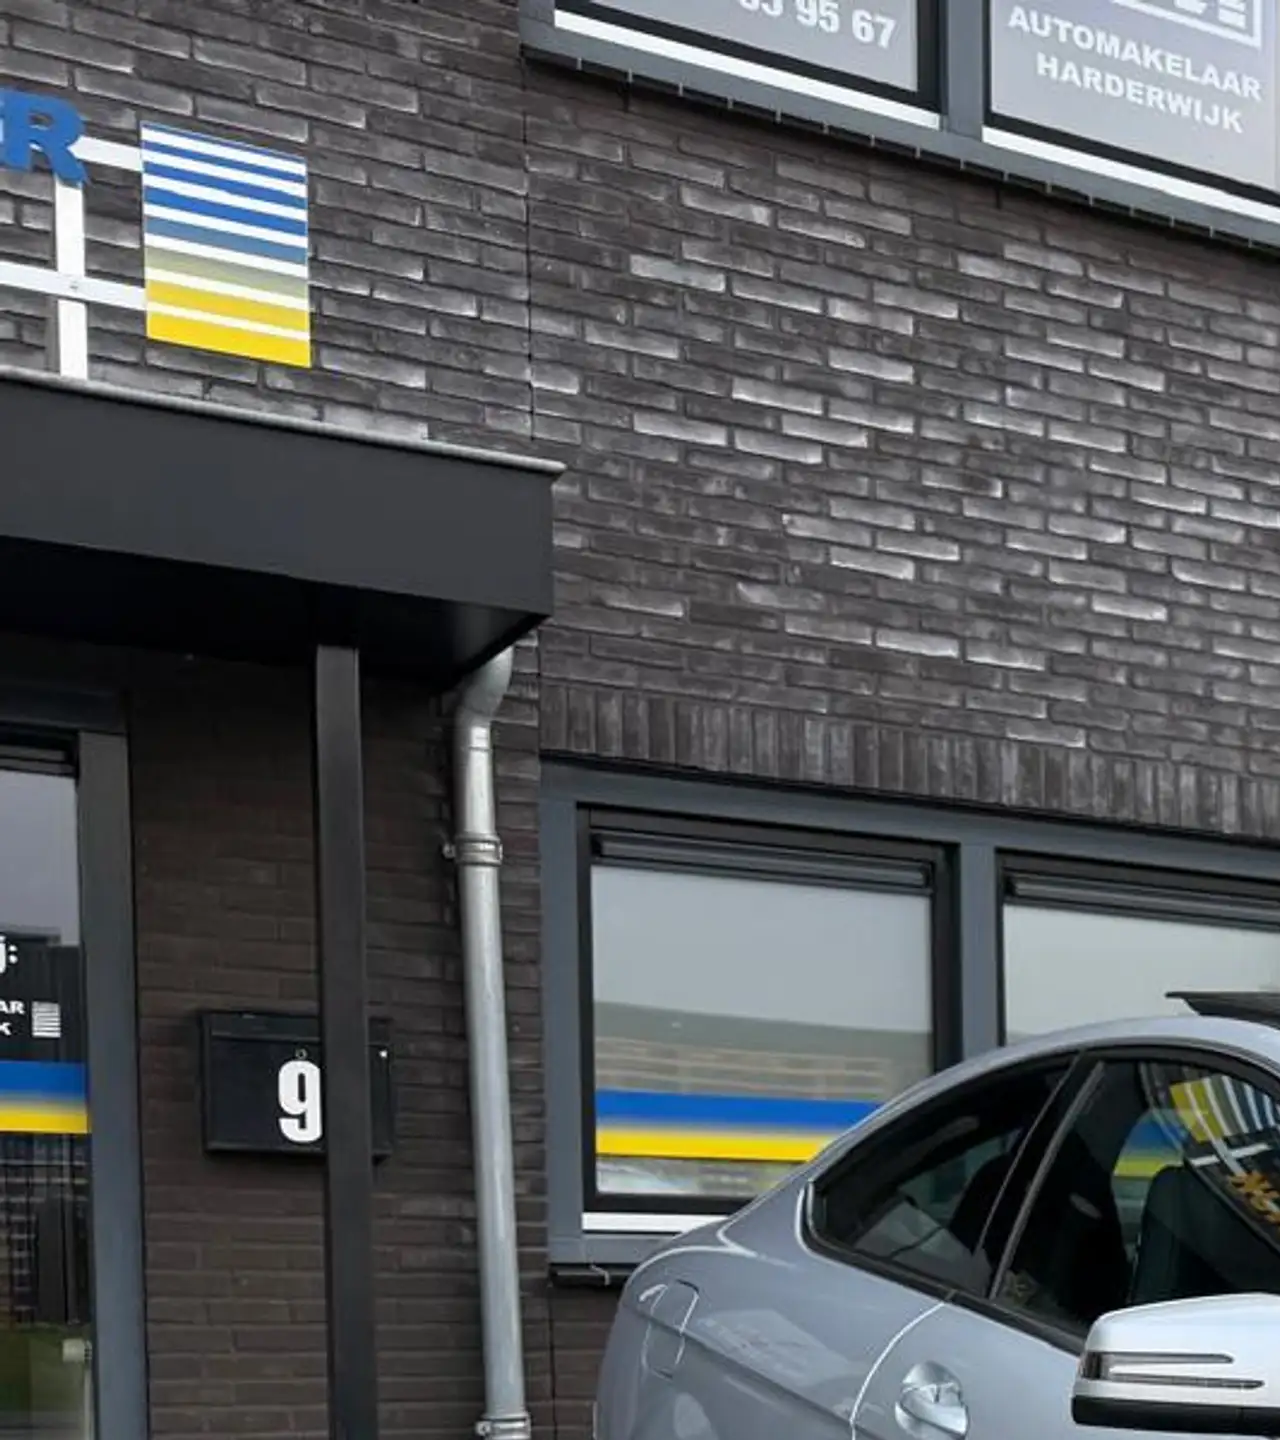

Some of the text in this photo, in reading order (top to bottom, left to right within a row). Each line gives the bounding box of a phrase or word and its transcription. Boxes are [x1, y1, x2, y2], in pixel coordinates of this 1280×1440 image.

[795, 0, 840, 33] 95
[852, 9, 896, 48] 67
[1008, 5, 1262, 101] AUTOMAKELAAR
[1036, 52, 1243, 133] HARDERWIJK
[278, 1059, 322, 1143] 9
